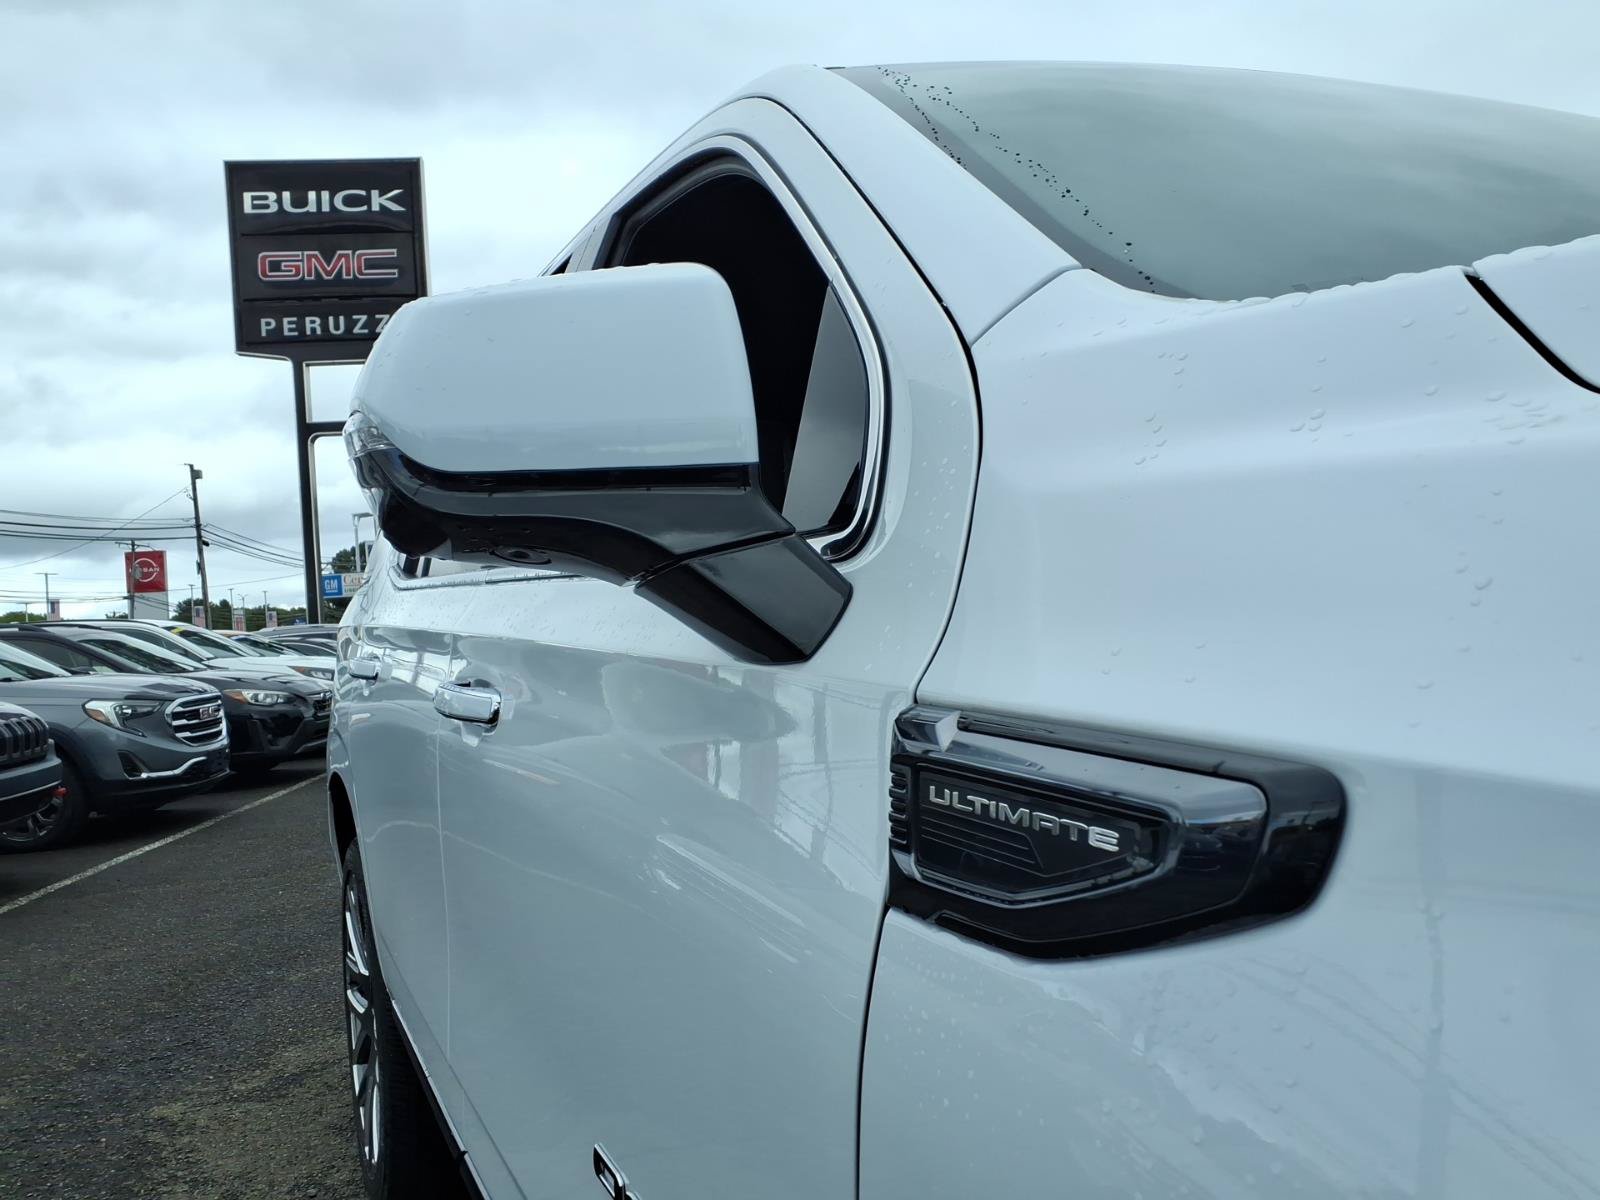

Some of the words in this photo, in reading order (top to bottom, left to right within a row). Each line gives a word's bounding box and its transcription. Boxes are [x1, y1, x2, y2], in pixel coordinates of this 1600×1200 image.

[243, 189, 406, 214] BUICK
[258, 248, 399, 281] GMC
[324, 578, 339, 591] GM
[929, 785, 1120, 852] ULTIMATE
